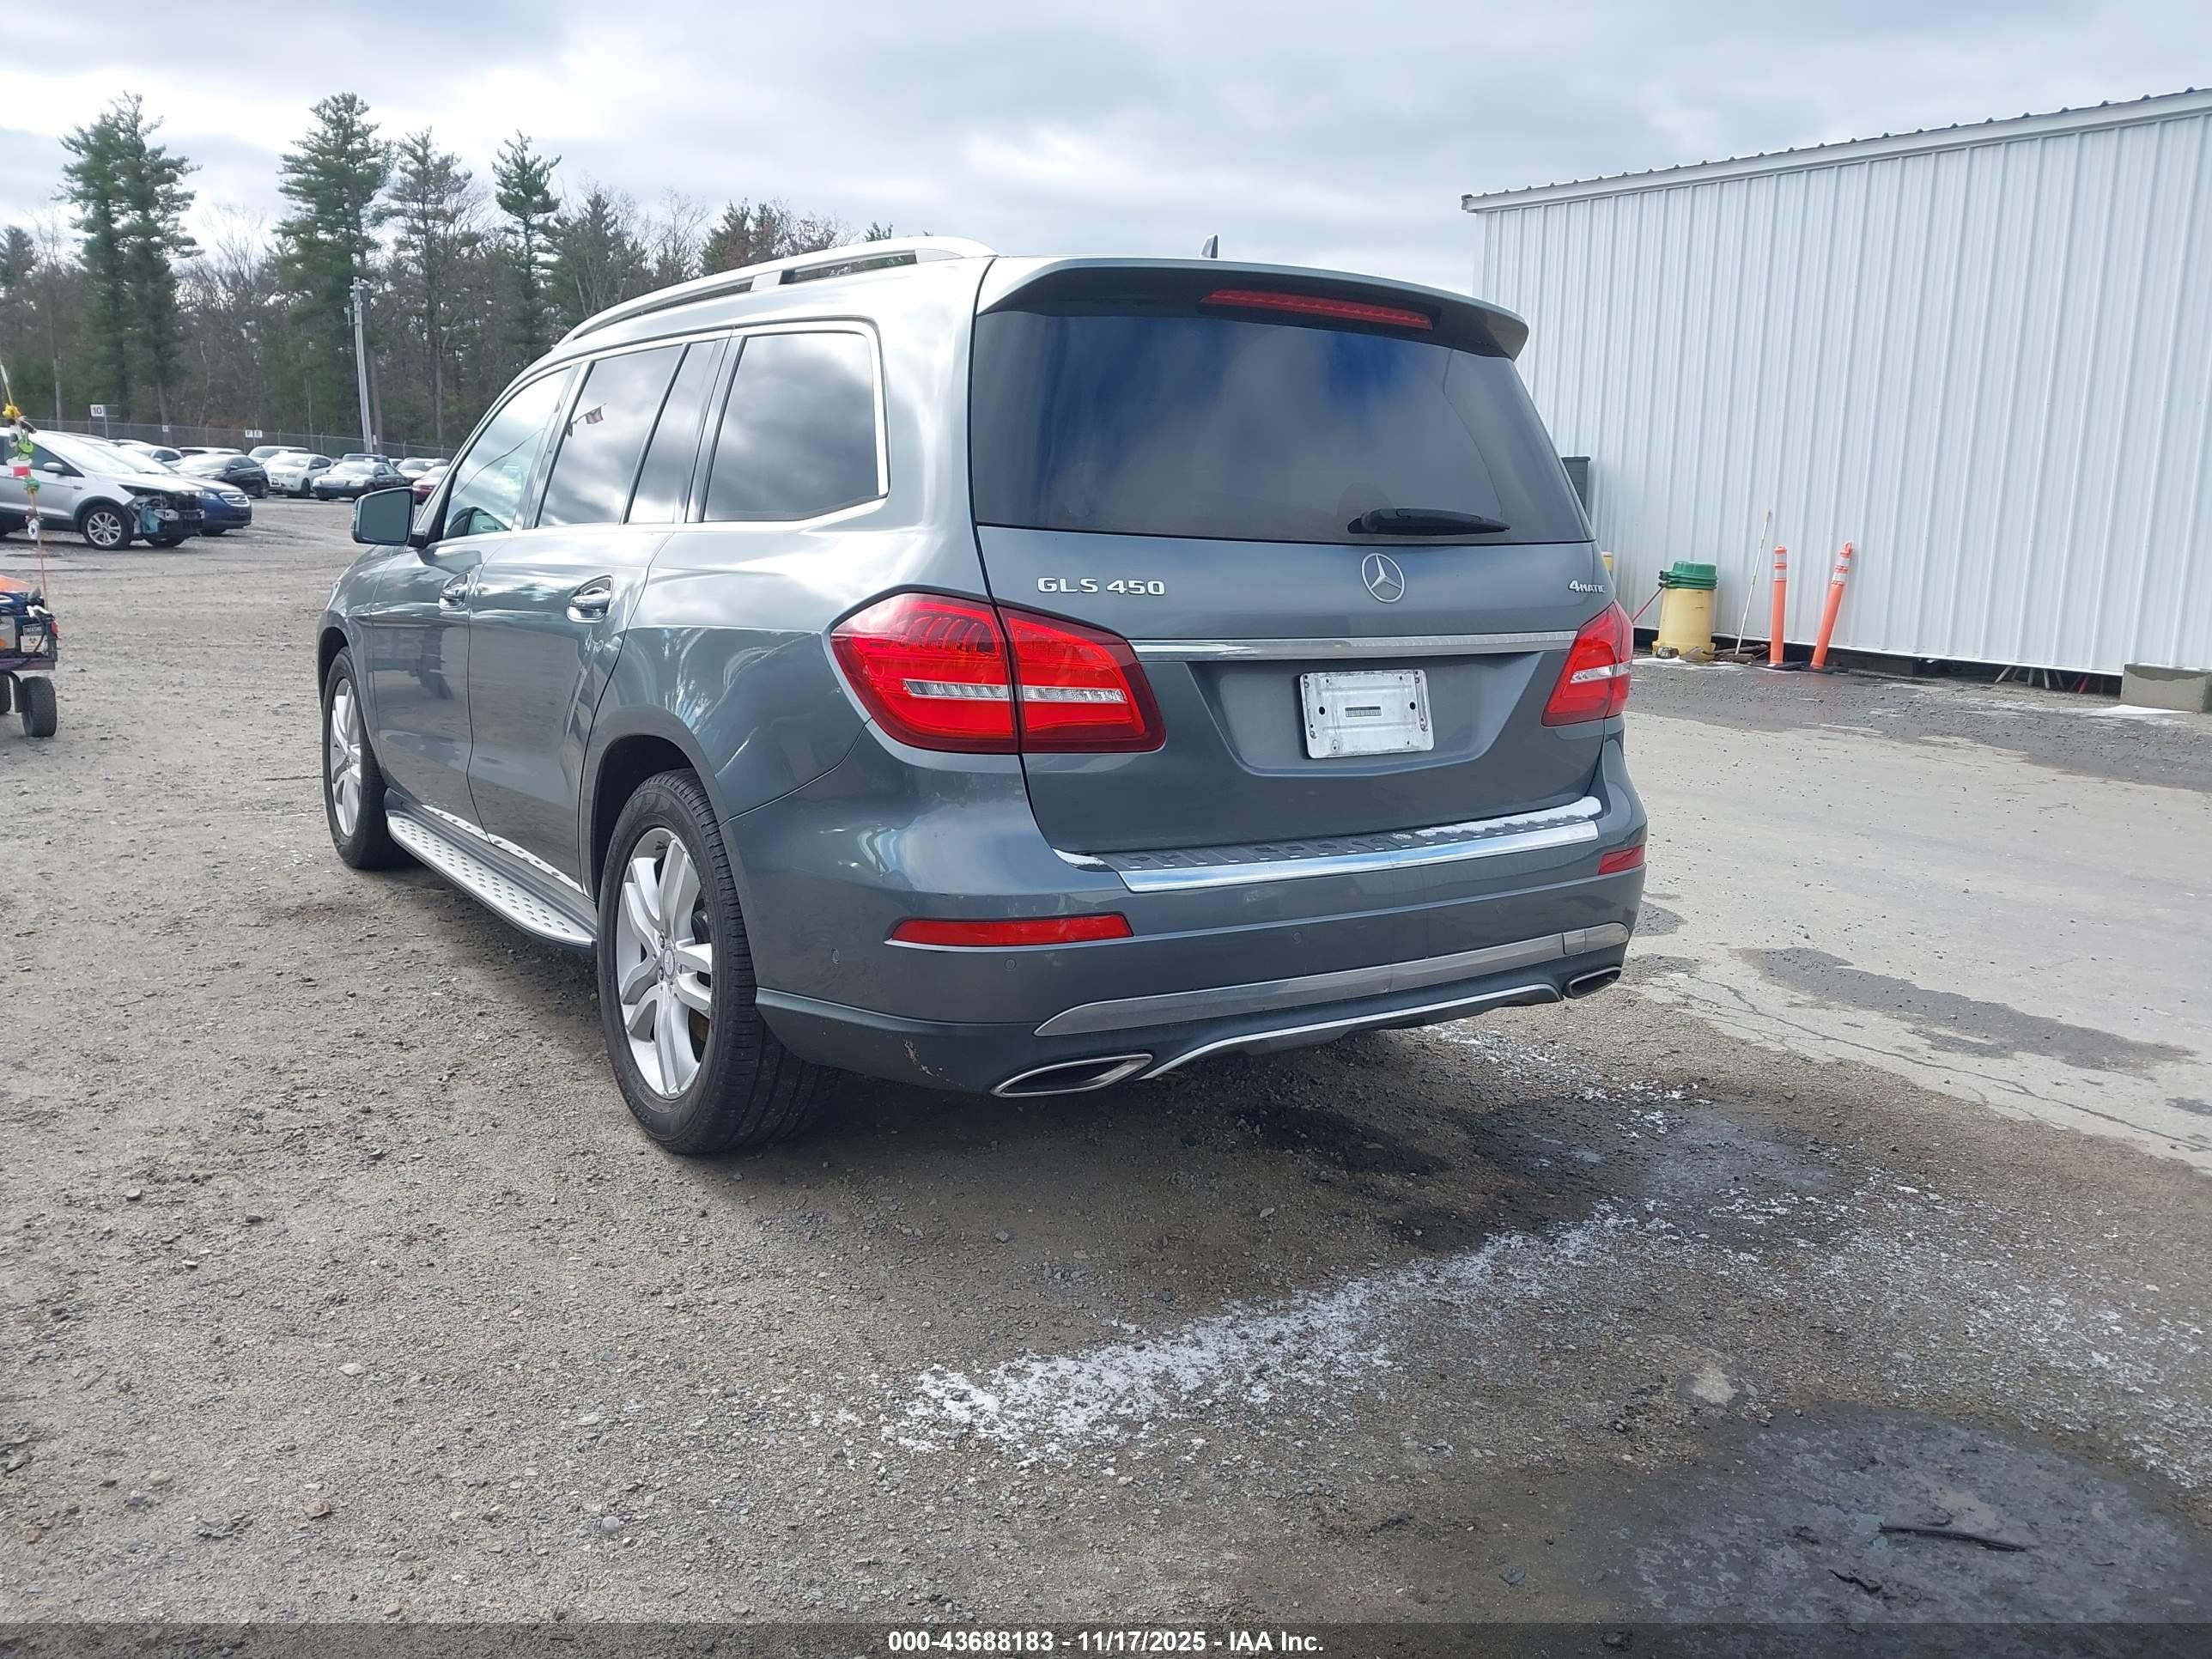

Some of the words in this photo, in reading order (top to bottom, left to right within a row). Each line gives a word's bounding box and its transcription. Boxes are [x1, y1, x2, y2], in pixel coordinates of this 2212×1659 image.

[93, 406, 102, 415] 10
[1037, 577, 1099, 593] GLS
[1106, 579, 1165, 596] 450
[1568, 580, 1607, 593] 4MATIC
